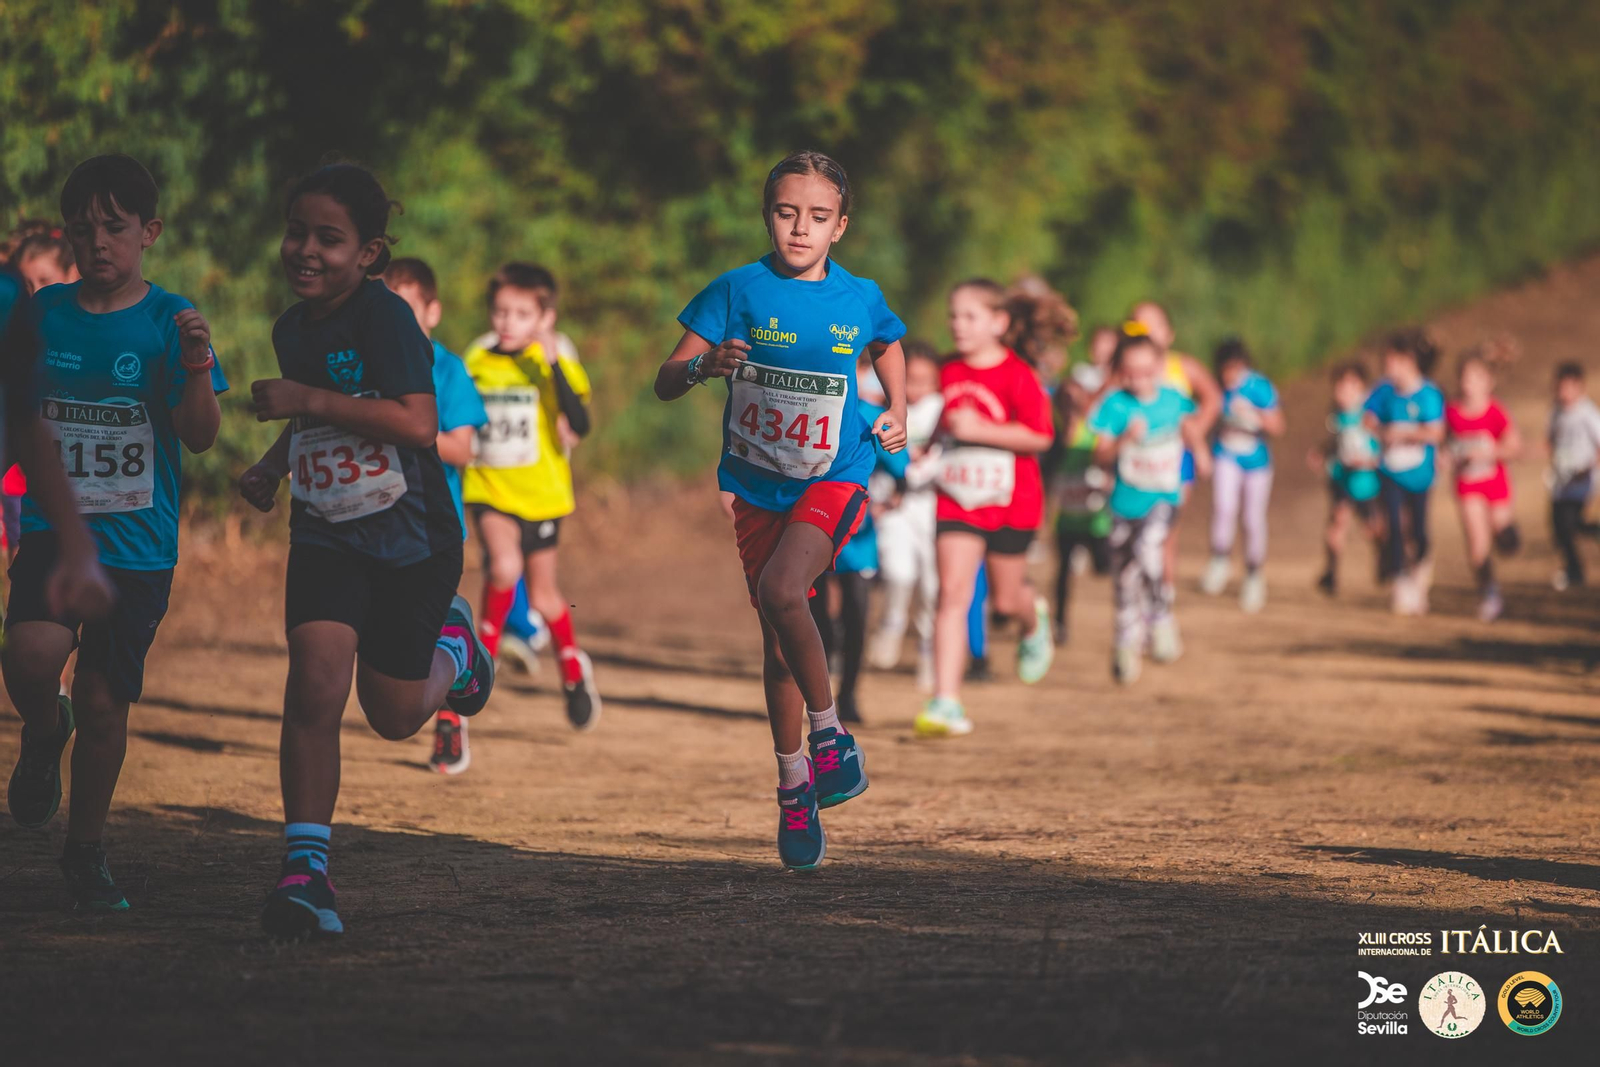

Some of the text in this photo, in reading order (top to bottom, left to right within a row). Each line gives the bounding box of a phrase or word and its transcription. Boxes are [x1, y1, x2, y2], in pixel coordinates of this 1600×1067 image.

[750, 326, 797, 344] CÓDOMO
[56, 359, 81, 370] barrio
[60, 352, 82, 361] niños
[764, 373, 818, 391] ITÁLICA
[768, 398, 808, 408] INDEPENDIENTE
[65, 405, 121, 423] ITÁLICA
[739, 402, 831, 450] 4341
[297, 440, 390, 492] 4533
[810, 507, 829, 519] KIPSTA
